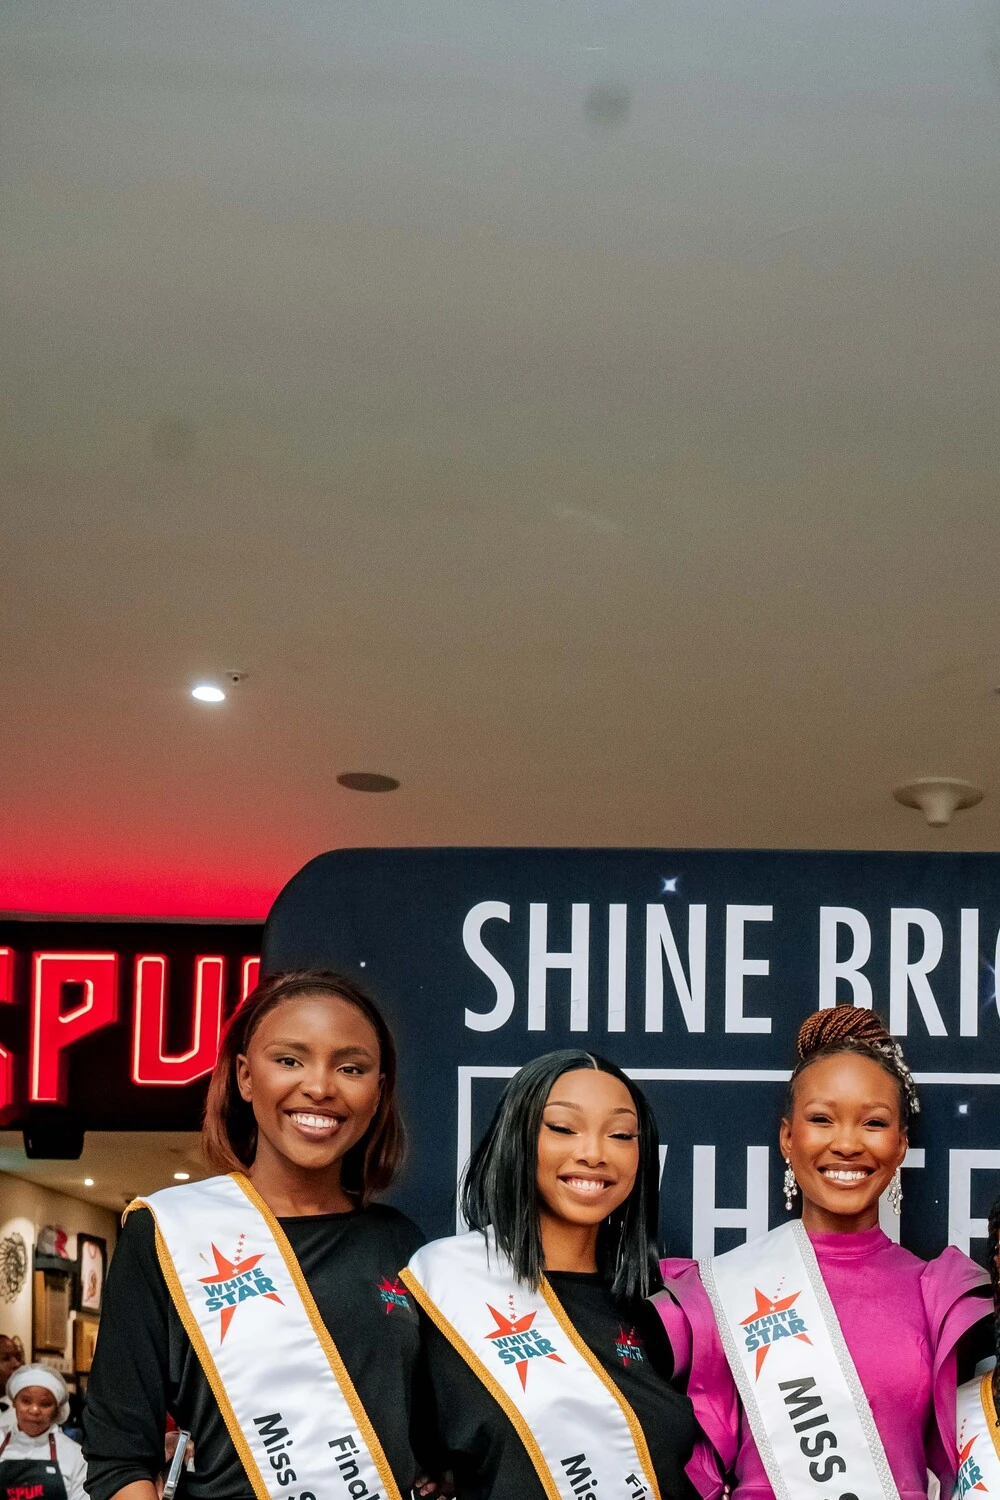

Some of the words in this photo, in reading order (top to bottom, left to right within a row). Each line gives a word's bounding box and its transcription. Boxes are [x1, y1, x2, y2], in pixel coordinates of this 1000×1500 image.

[462, 900, 774, 1033] SHINE
[0, 946, 262, 1108] PU
[203, 1267, 265, 1298] WHITE
[205, 1276, 279, 1312] STAR
[490, 1328, 543, 1350] WHITE
[743, 1308, 799, 1335] WHITE
[744, 1318, 809, 1353] STAR
[497, 1338, 558, 1365] STAR
[778, 1376, 847, 1483] MISS
[253, 1412, 297, 1486] Miss
